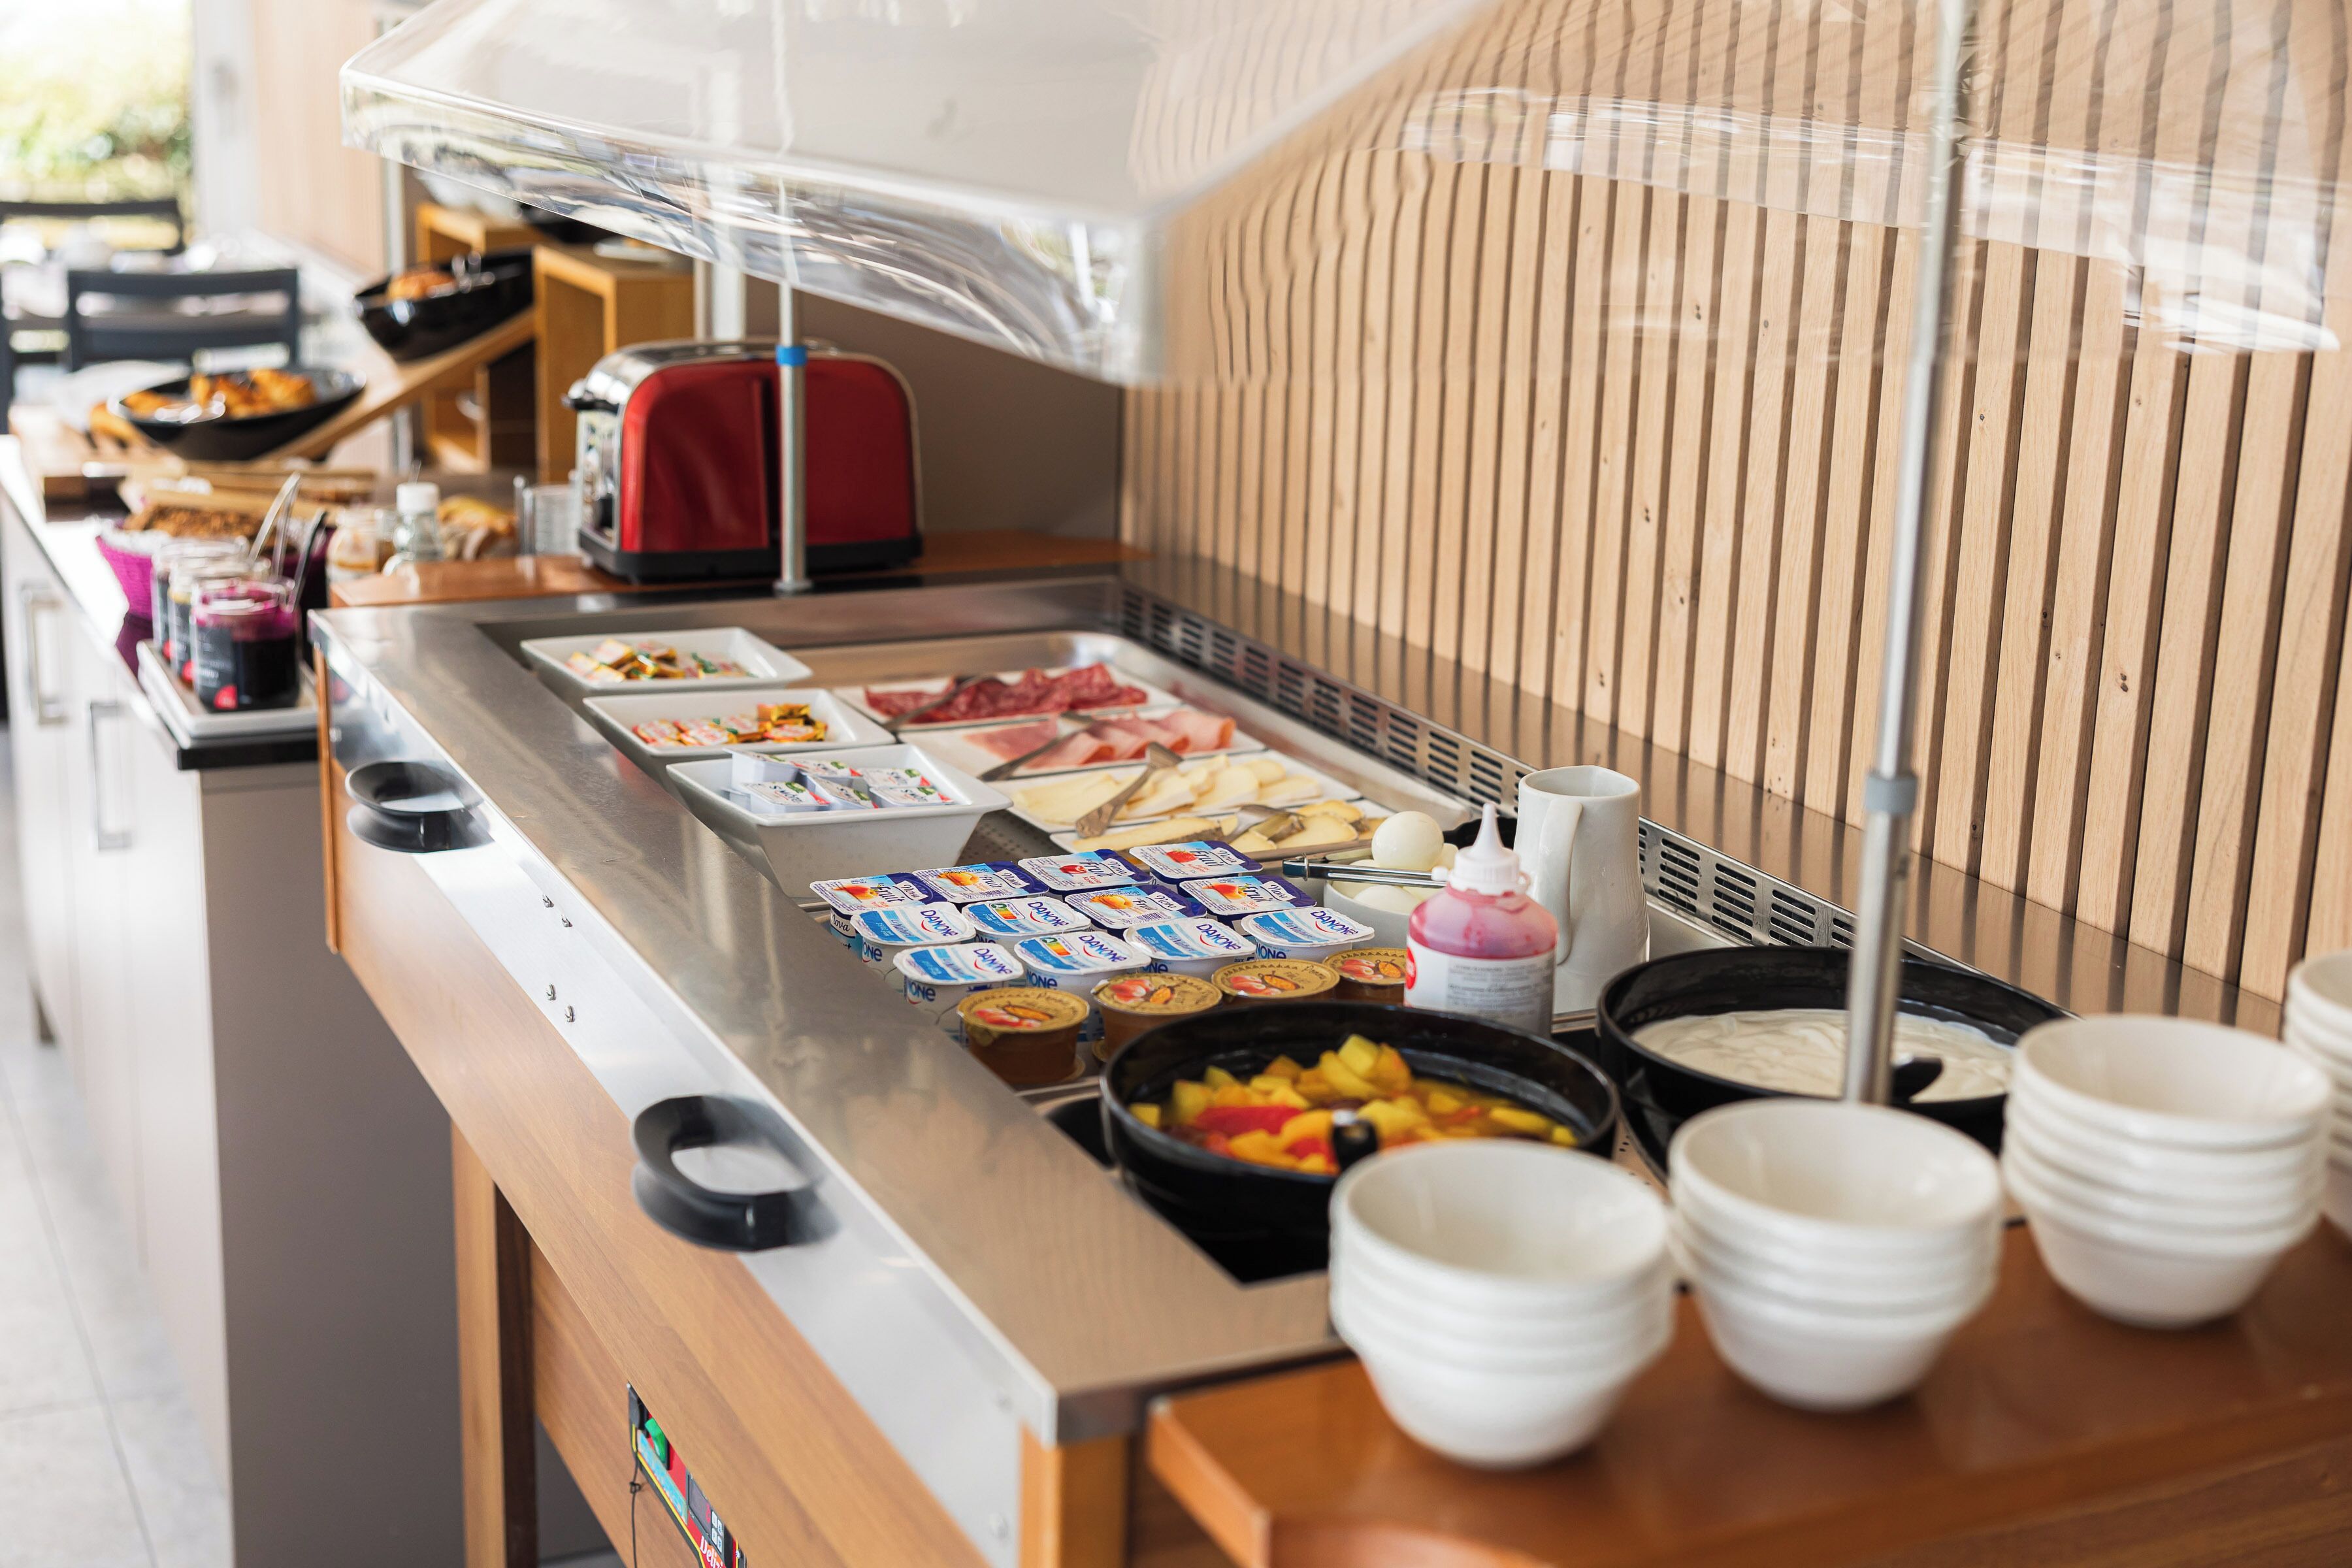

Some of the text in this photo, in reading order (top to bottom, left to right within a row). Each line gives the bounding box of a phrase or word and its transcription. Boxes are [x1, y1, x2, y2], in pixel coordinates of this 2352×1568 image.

[1189, 851, 1224, 866] Fruit
[1079, 862, 1113, 877] Fruit
[979, 876, 1003, 888] Fruit
[870, 886, 905, 902] Fruit
[1238, 885, 1273, 902] Fruit
[832, 914, 851, 932] Nova
